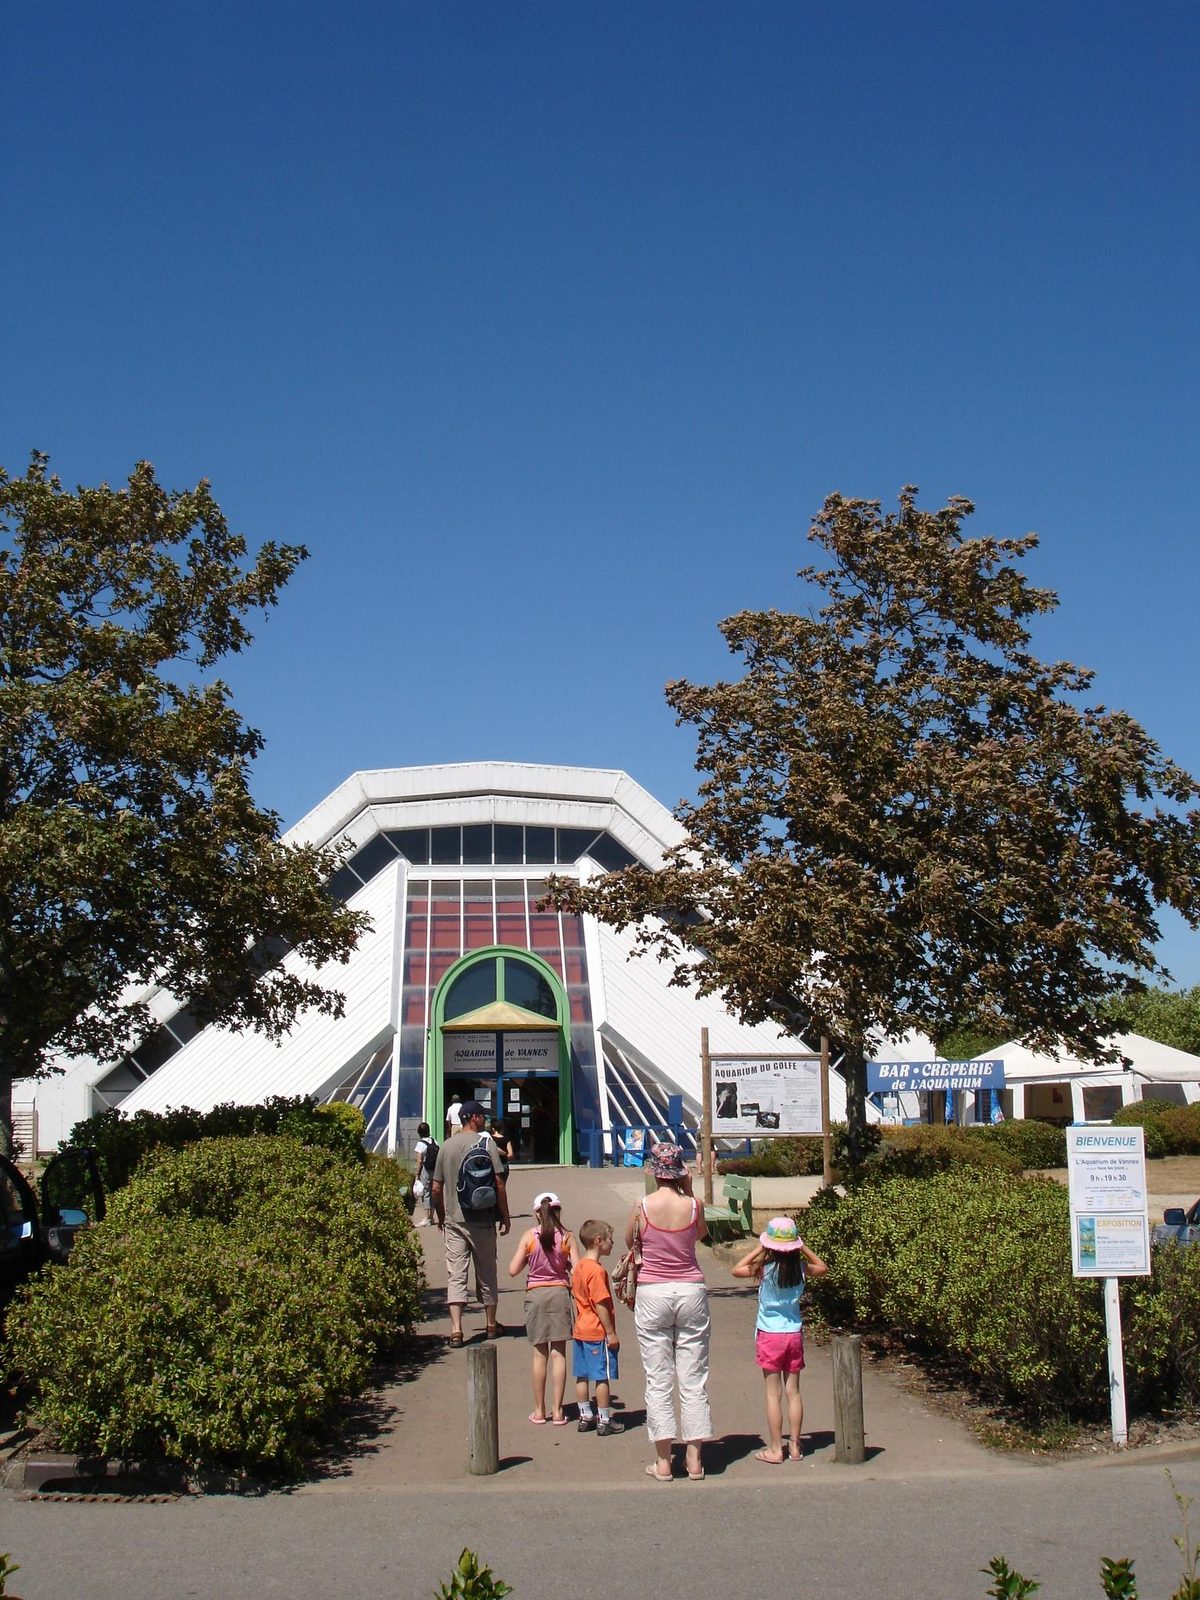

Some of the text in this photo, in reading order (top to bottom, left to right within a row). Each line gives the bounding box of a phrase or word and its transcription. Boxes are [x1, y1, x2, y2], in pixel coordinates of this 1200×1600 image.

[454, 1048, 549, 1057] AQUARIUM de VANNES
[715, 1061, 797, 1078] AQUARIUM DU GOLFE
[879, 1062, 994, 1078] BAR CREPERIE
[891, 1077, 982, 1091] de L'AQUARIUM
[1076, 1136, 1137, 1147] BIENVENUE
[1075, 1158, 1109, 1166] L'Aquarium
[1090, 1174, 1095, 1182] 9
[1104, 1174, 1112, 1182] 19
[1118, 1174, 1127, 1182] 30
[1097, 1219, 1142, 1227] EXPOSITION
